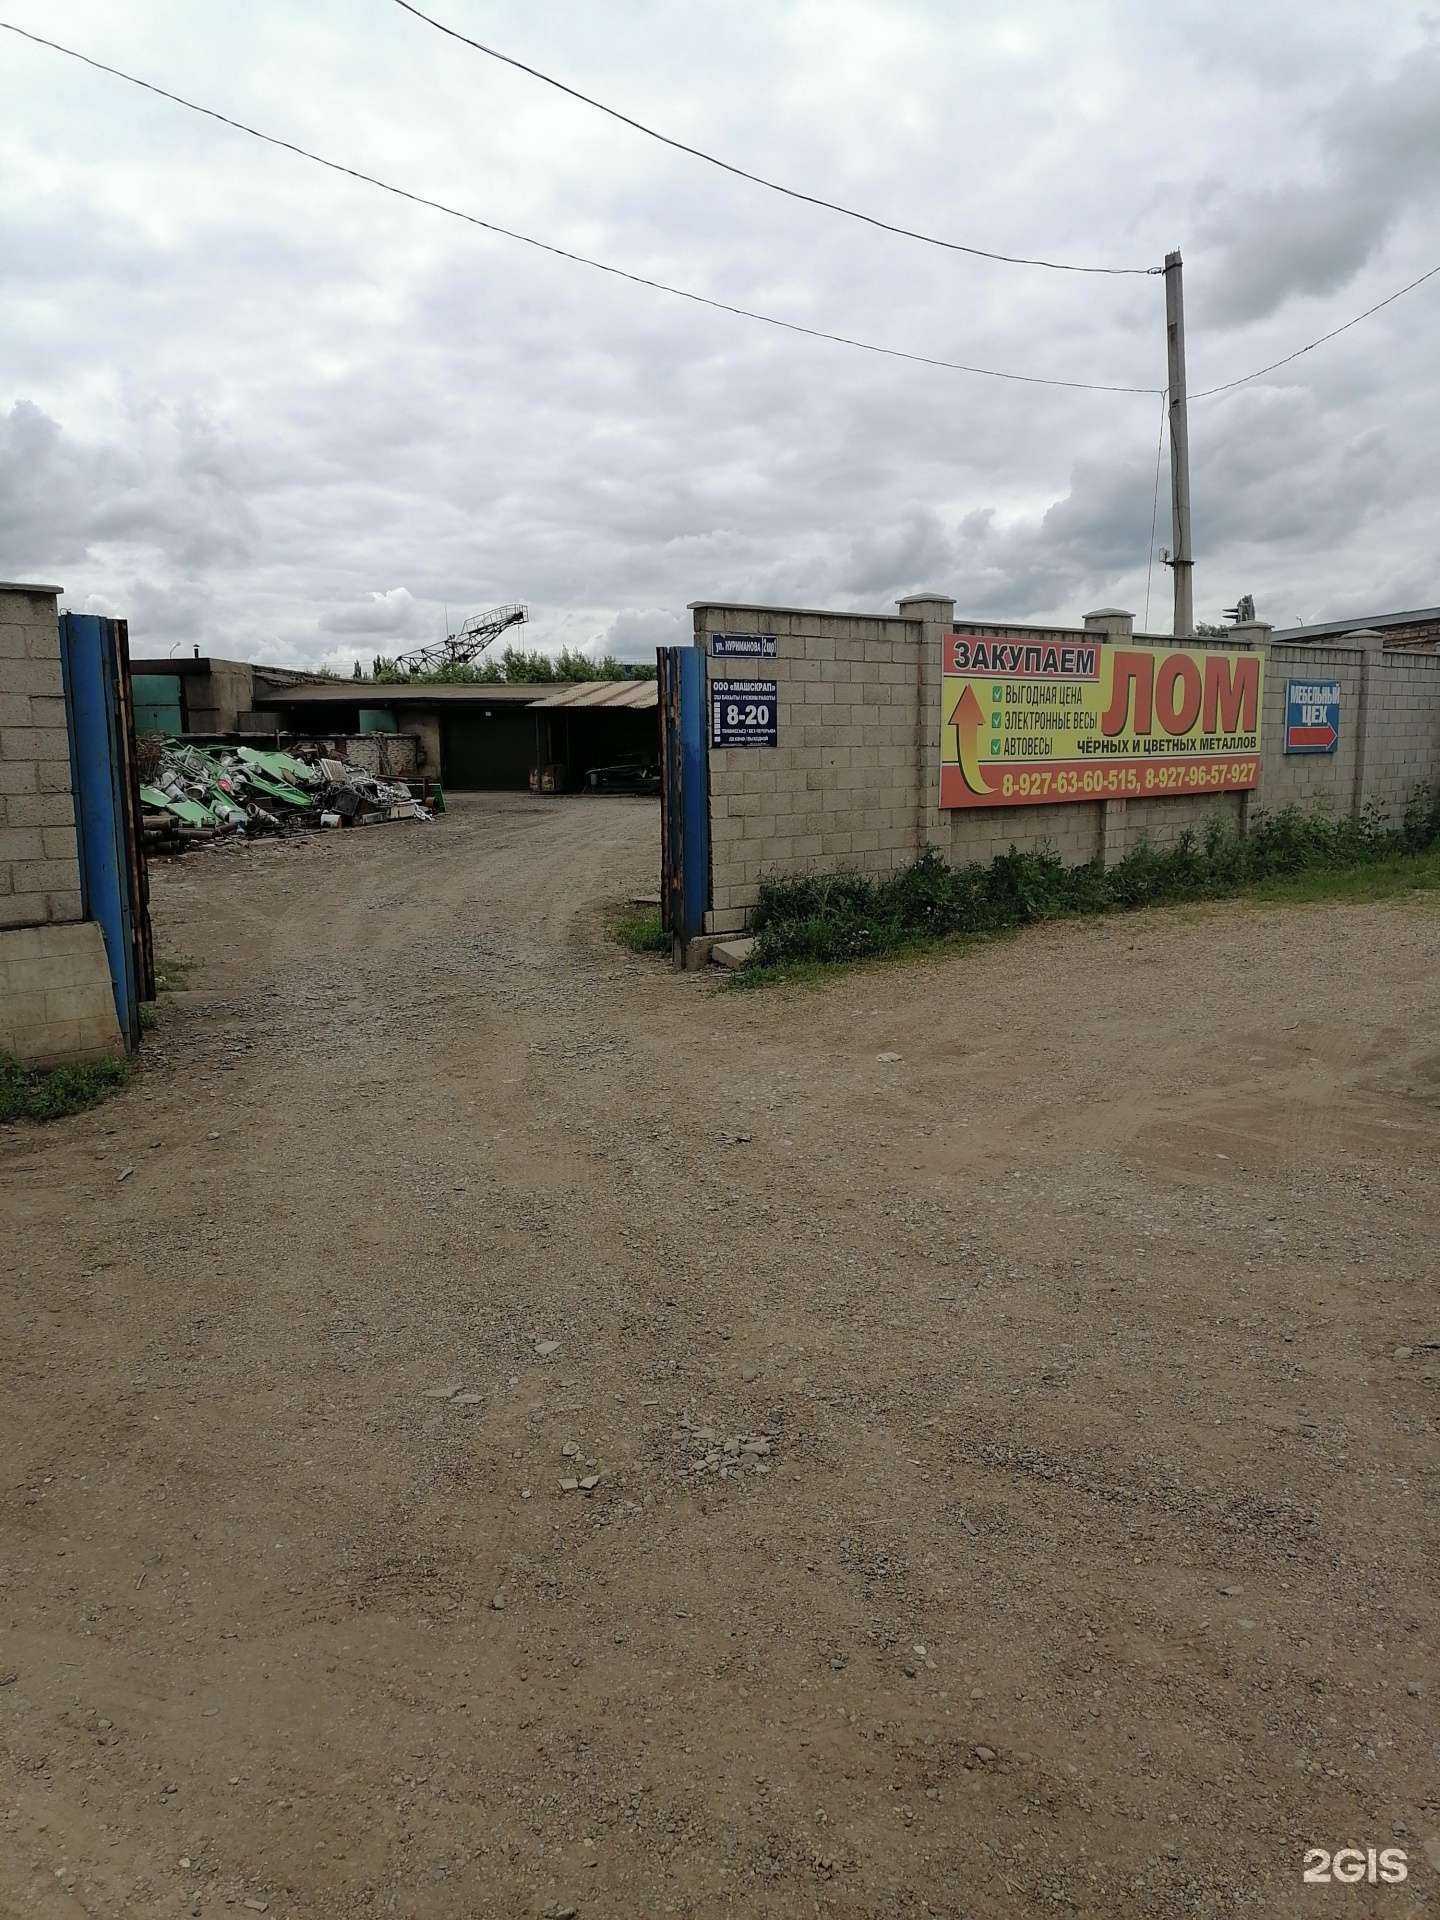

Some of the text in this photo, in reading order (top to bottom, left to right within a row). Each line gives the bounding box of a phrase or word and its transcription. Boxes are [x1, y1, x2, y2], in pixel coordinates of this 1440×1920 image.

[725, 640, 761, 652] НУРИМАНОВА
[954, 641, 1095, 674] ЗАКУПАЕМ
[713, 682, 776, 691] ООО «МАШСКРАП»
[1005, 685, 1082, 706] ВЫГОДНАЯ ЦЕНА
[1101, 651, 1260, 737] ЛОМ
[1291, 682, 1340, 704] МЕБЕЛЬНЫЙ
[727, 704, 769, 725] 8-20
[1004, 711, 1097, 730] ЭЛЕКТРОННЫЕ ВЕСЫ
[1302, 705, 1328, 726] ЦЕХ
[1003, 737, 1052, 756] АВТОВЕСЫ
[1077, 736, 1256, 754] ЧЁРНЫХ И ЦВЕТНЫХ МЕТАЛЛОВ
[1002, 763, 1257, 797] 8-927-63-60-515, 8-927-96-57-927
